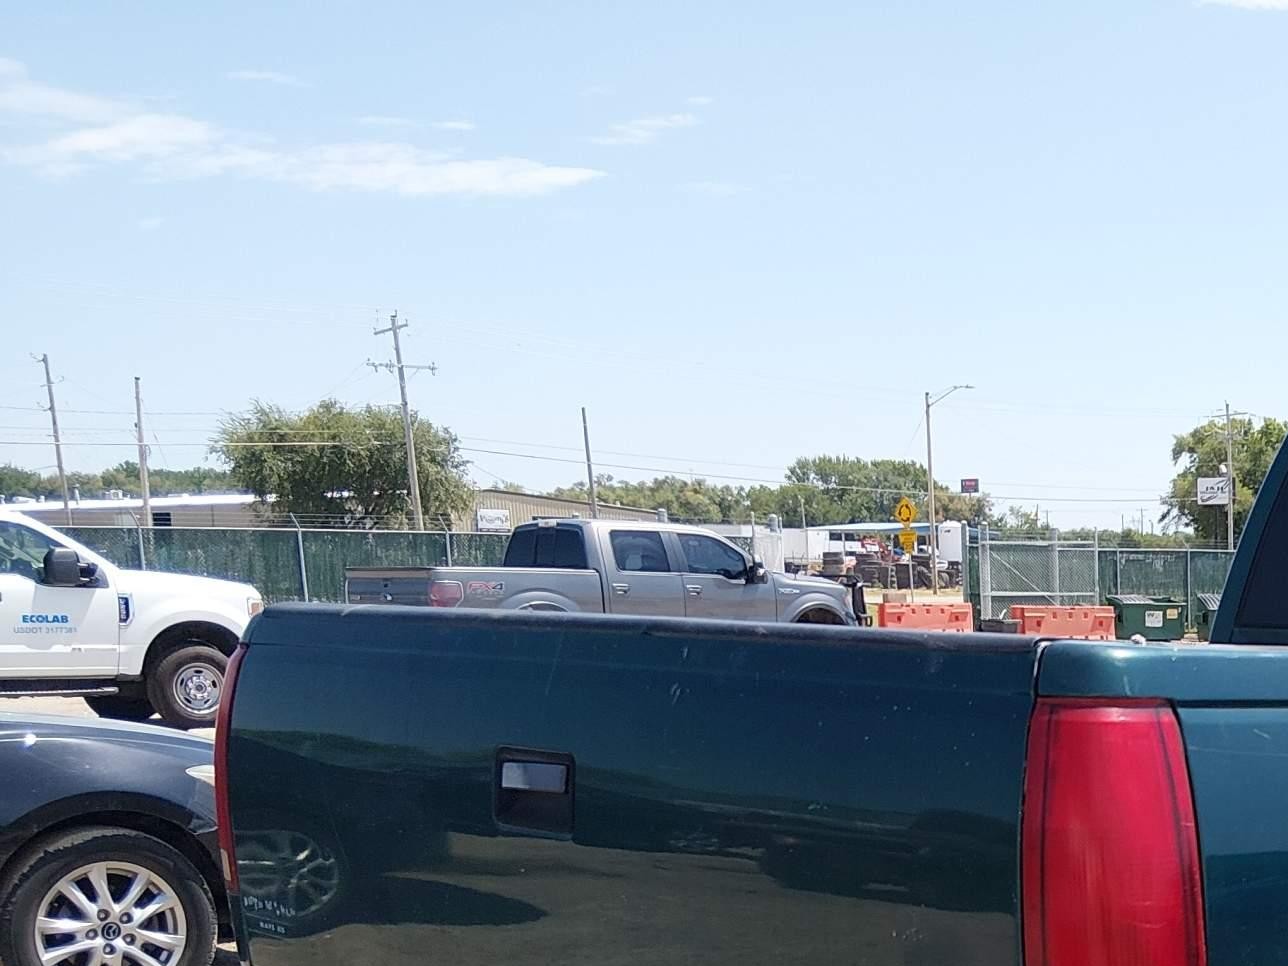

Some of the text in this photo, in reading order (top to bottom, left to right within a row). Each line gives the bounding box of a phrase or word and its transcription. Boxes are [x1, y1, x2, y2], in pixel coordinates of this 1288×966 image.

[467, 581, 504, 593] FX4
[21, 614, 69, 624] ECOLAB
[13, 626, 42, 635] USDOT
